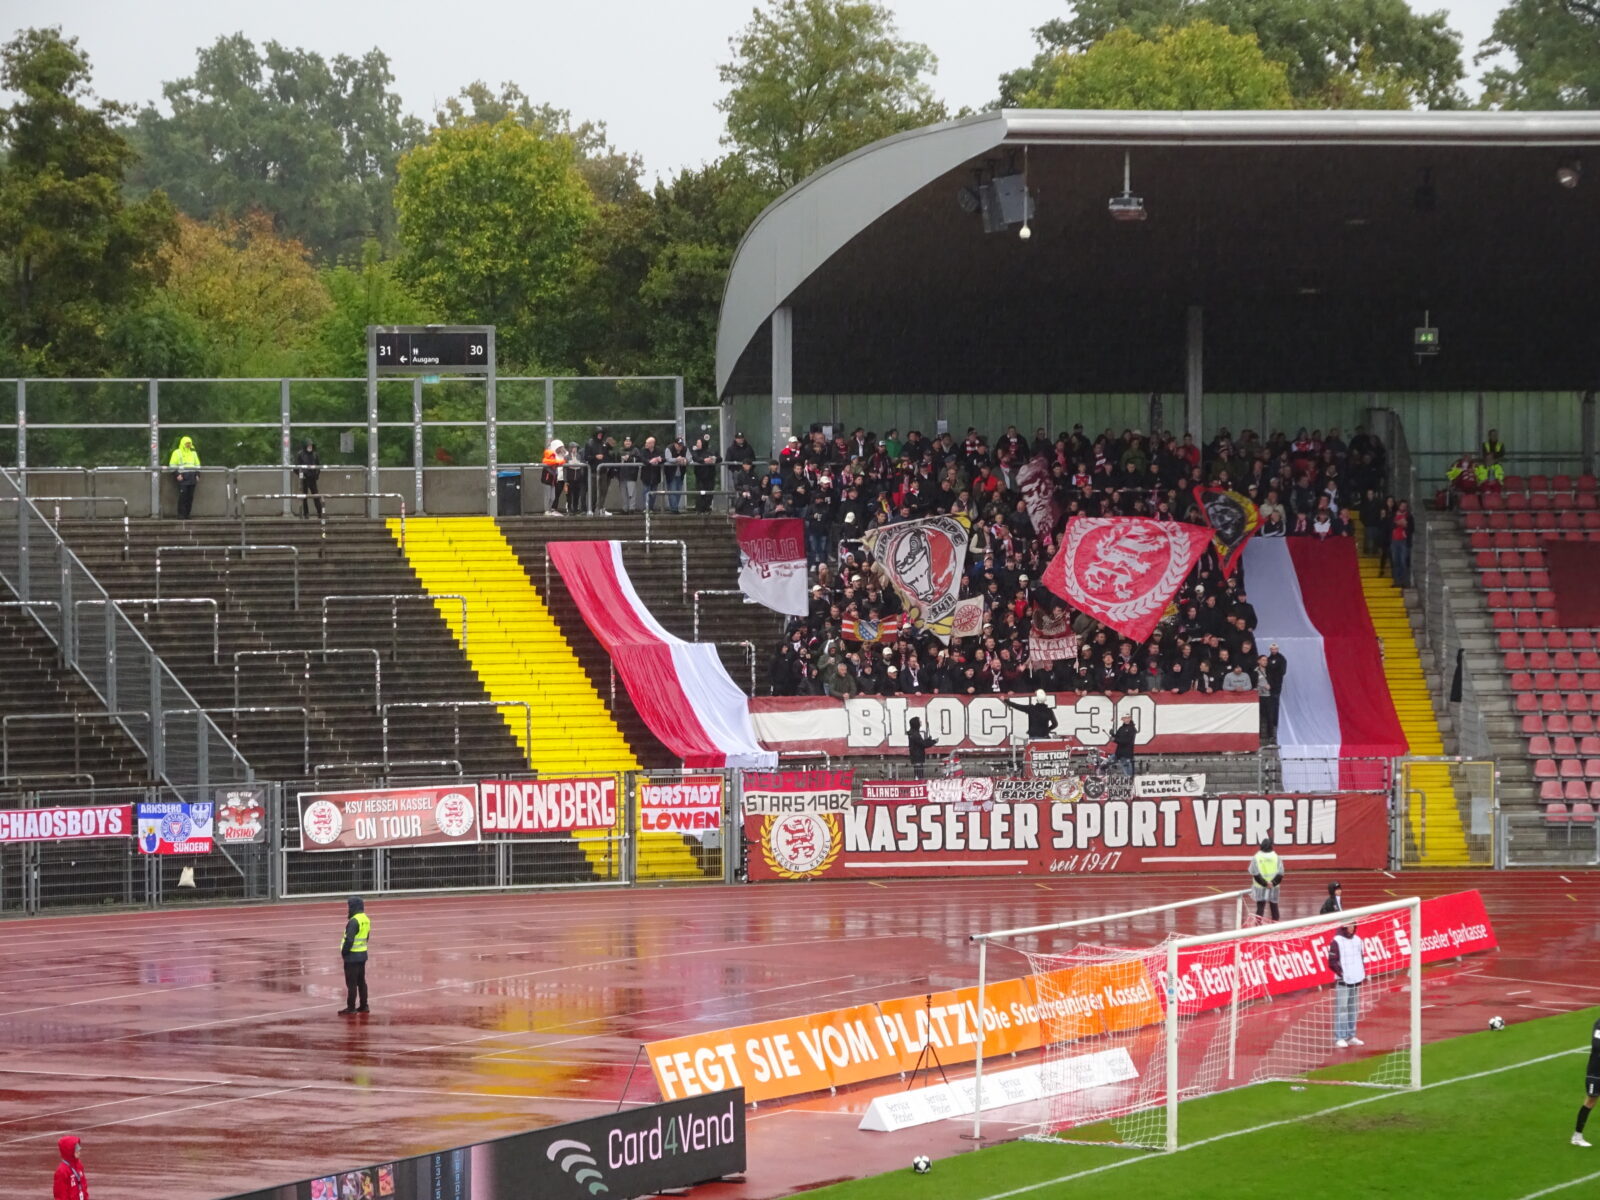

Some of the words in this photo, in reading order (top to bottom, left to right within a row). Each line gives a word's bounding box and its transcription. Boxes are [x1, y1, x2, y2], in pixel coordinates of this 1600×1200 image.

[379, 345, 391, 356] 31
[412, 356, 440, 364] Ausgang
[470, 345, 483, 356] 30
[1075, 695, 1156, 746] 30
[1032, 751, 1069, 761] SEKTION
[641, 784, 720, 806] VORSTADT
[746, 794, 805, 812] STARS
[807, 793, 850, 812] 1982
[910, 786, 924, 797] 913
[1001, 790, 1044, 800] BANDE
[140, 803, 182, 814] ARNSBERG
[345, 801, 363, 814] KSV
[365, 798, 399, 813] HESSEN
[400, 796, 433, 810] KASSEL
[481, 780, 616, 829] GUDENSBERG
[0, 808, 122, 839] CHAOSBOYS
[355, 818, 377, 840] ON
[381, 815, 422, 838] TOUR
[642, 809, 720, 831] LÖWEN
[844, 802, 1039, 852] KASSELER
[1051, 800, 1181, 850] SPORT
[1193, 799, 1337, 847] VEREIN
[173, 842, 209, 853] SUNDERN
[1049, 853, 1078, 872] seit
[1080, 852, 1122, 872] 1947
[1416, 930, 1450, 953] asseler
[1190, 962, 1242, 998] Team
[1240, 951, 1270, 988] für
[1269, 943, 1317, 982] deine
[981, 1006, 1012, 1032] Die
[1010, 992, 1105, 1027] Stadtreiniger
[1103, 977, 1152, 1007] Kassel
[655, 1043, 743, 1099] FEGT
[746, 1034, 801, 1083] SIE
[796, 1020, 880, 1072] VOM
[874, 999, 986, 1057] PLATZ!
[608, 1101, 735, 1169] Card4Vend
